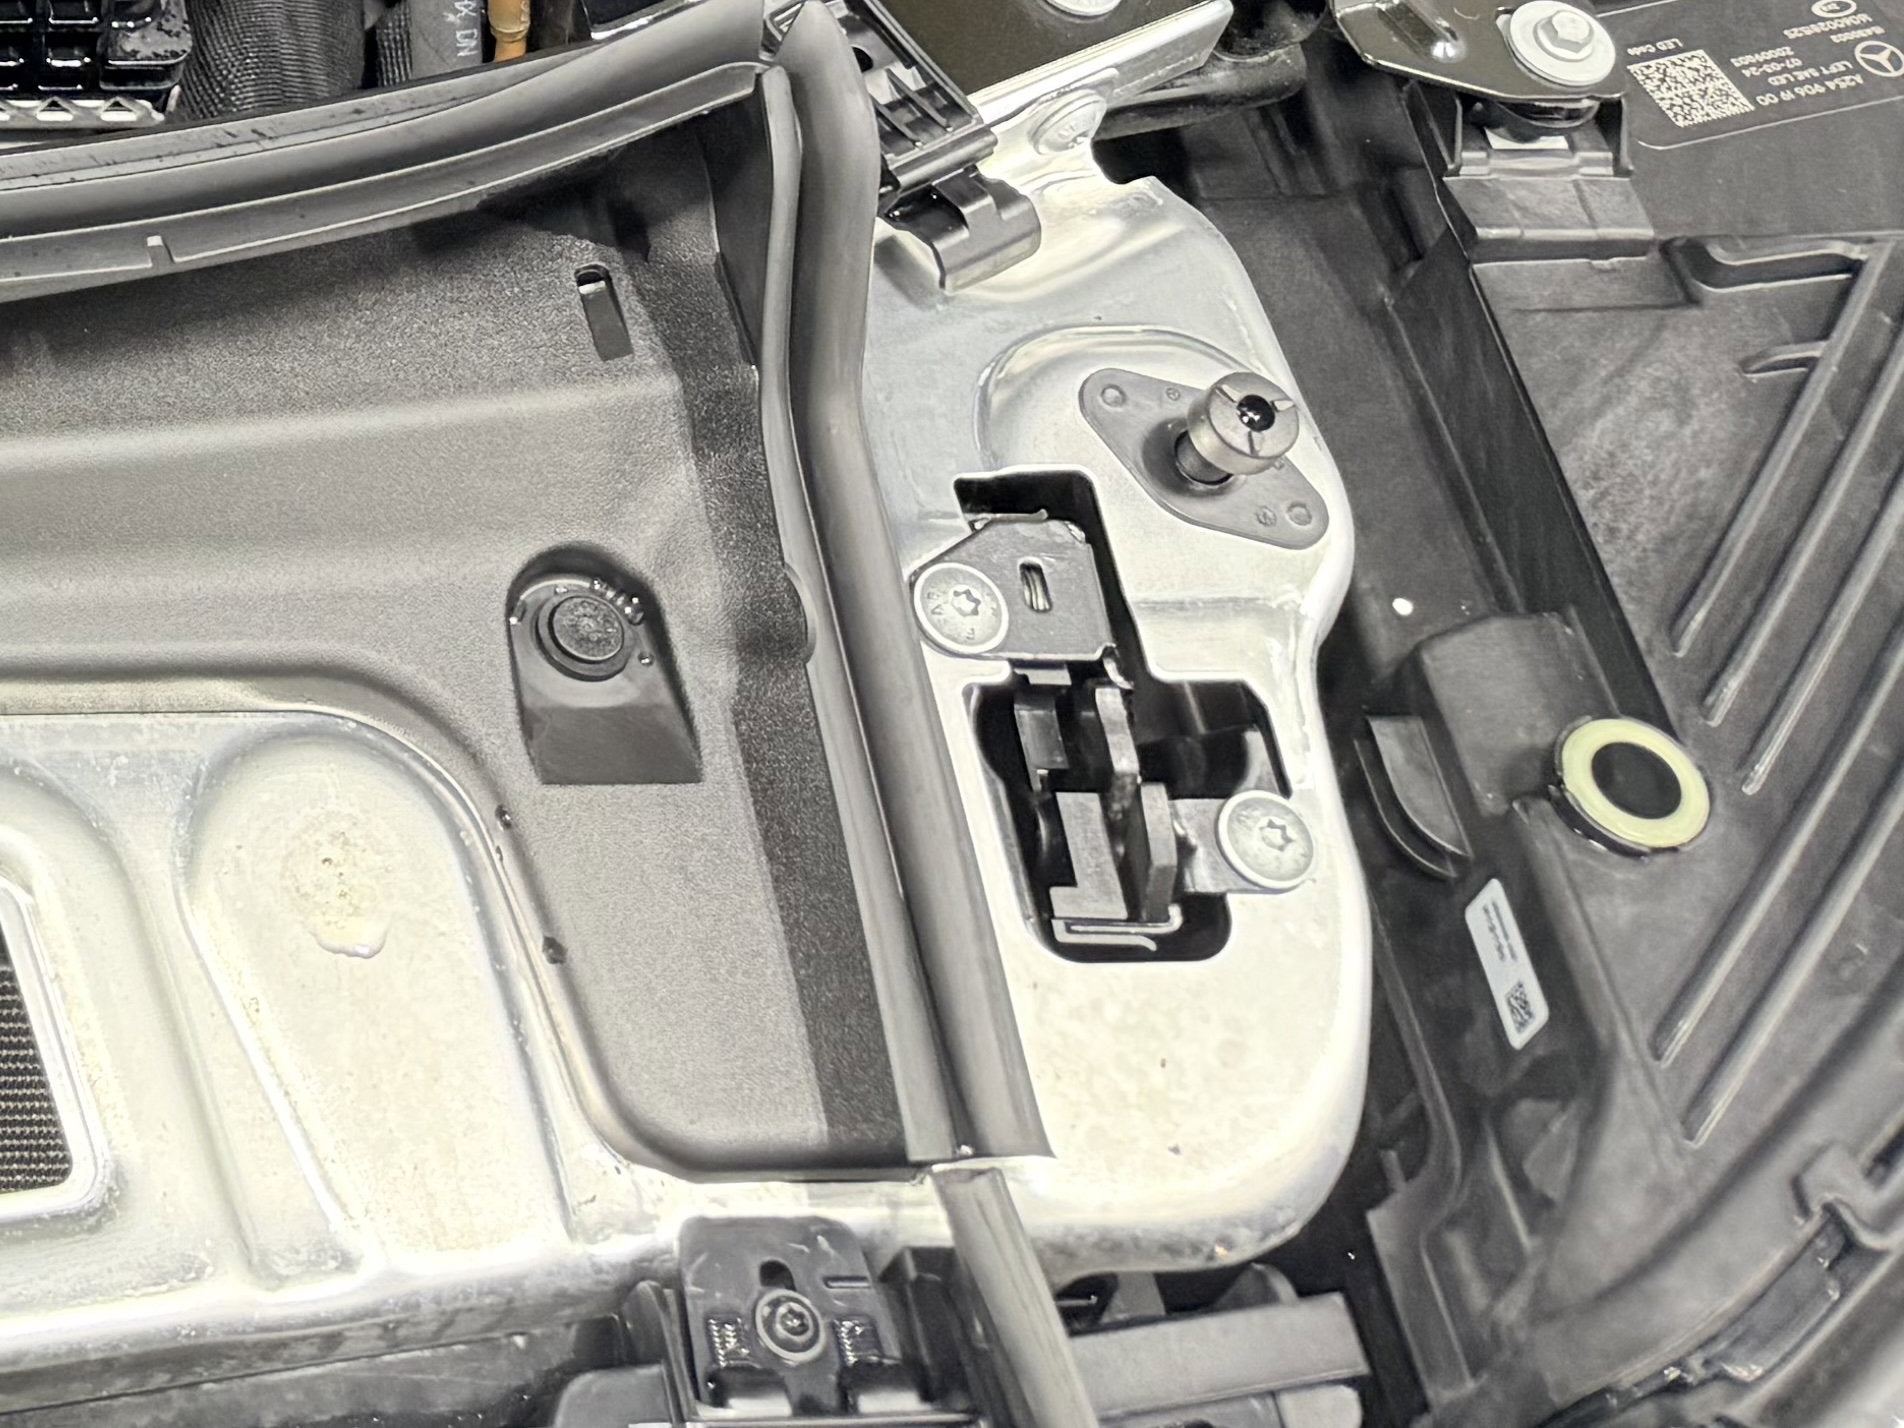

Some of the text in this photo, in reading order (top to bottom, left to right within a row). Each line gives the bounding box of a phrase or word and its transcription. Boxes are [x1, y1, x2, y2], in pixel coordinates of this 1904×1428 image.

[1819, 60, 1854, 75] LEFT
[1794, 81, 1826, 98] 906
[1827, 73, 1864, 91] A254
[1756, 94, 1779, 106] 00
